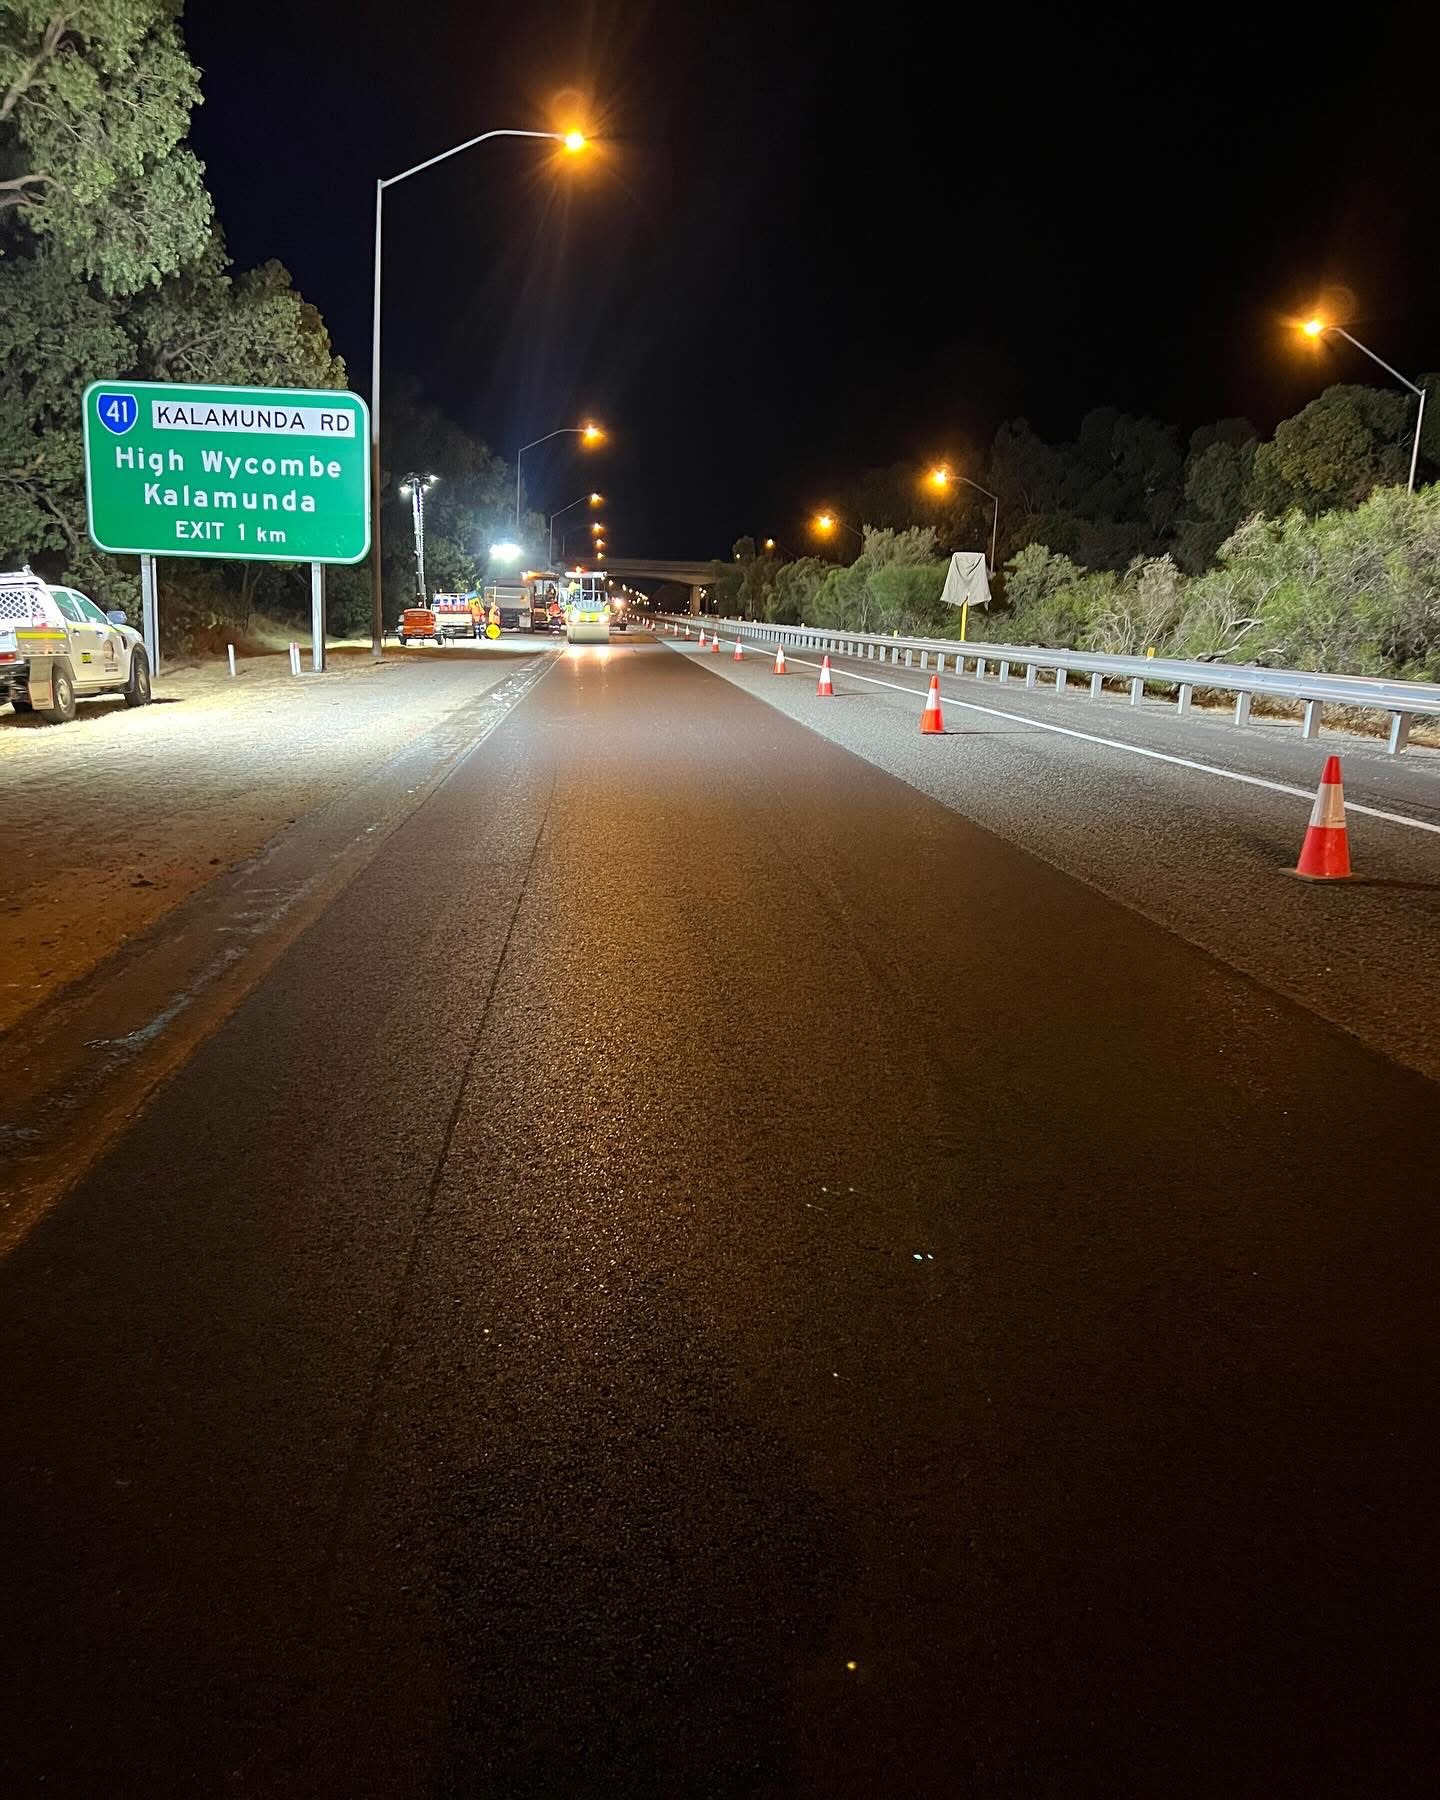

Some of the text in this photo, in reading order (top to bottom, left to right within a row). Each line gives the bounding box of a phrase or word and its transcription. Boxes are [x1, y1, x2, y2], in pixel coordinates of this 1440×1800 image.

[106, 400, 128, 423] 41
[157, 406, 350, 432] KALAMUNDA RD
[115, 446, 342, 479] High Wycombe
[144, 483, 316, 513] Kalamunda
[175, 520, 286, 543] EXIT 1 km
